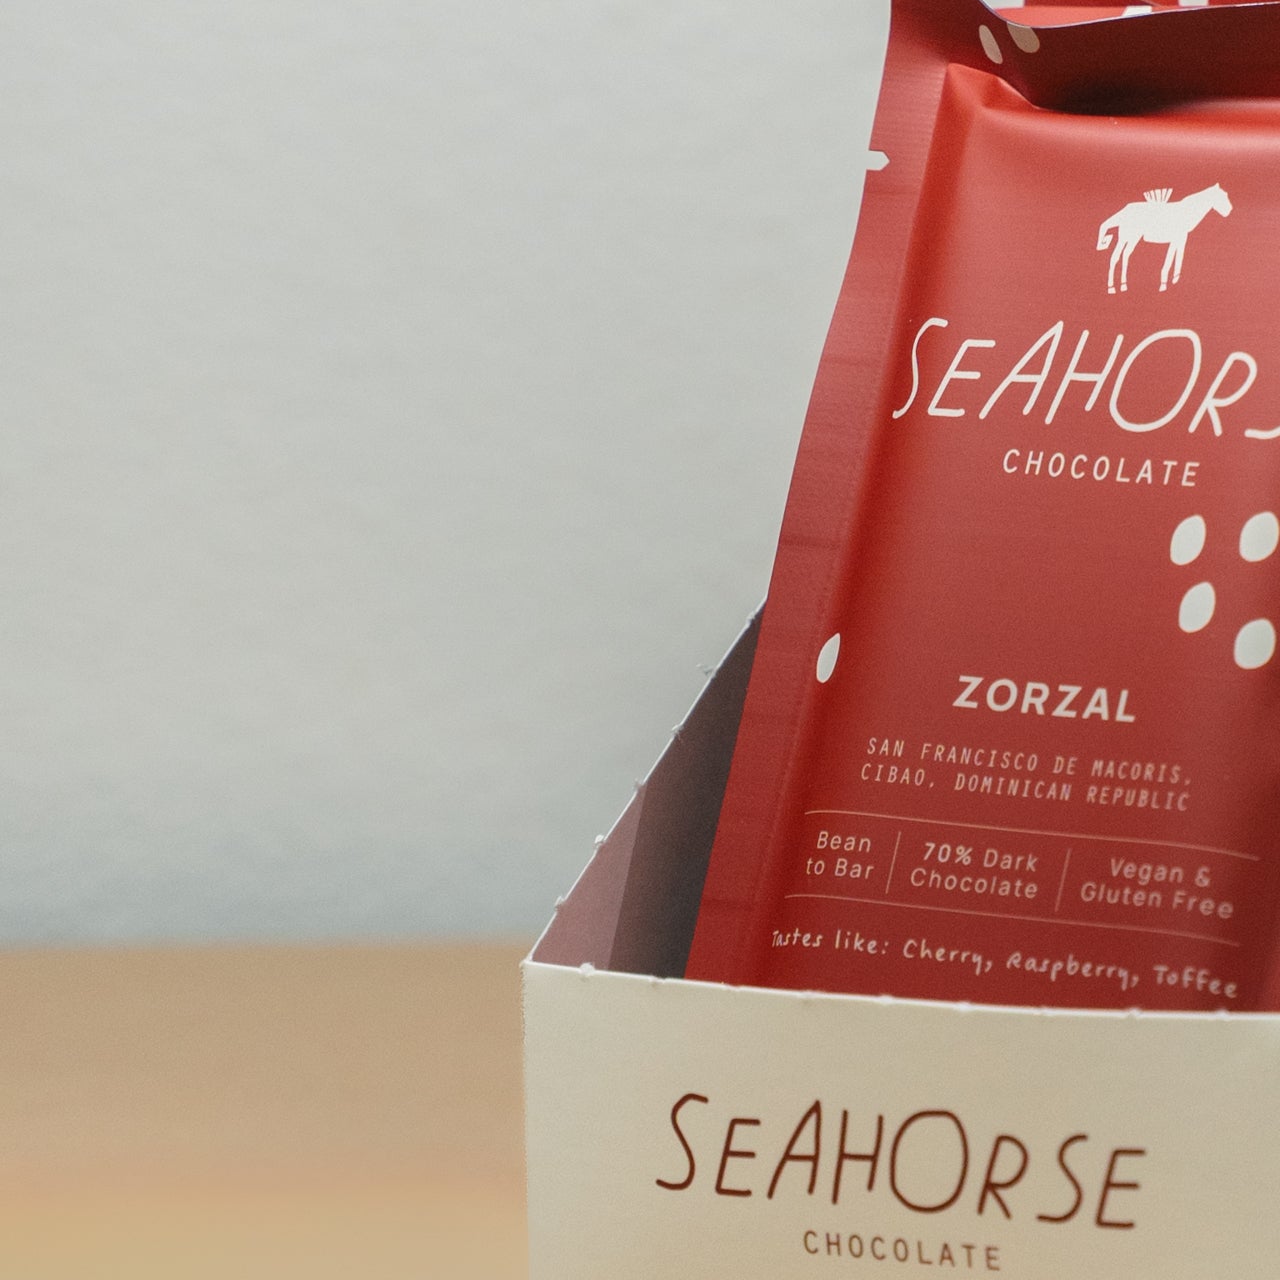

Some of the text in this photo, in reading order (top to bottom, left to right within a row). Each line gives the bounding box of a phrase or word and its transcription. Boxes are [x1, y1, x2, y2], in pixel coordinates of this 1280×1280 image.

[1002, 449, 1200, 487] CHOCOLATE
[952, 675, 1136, 723] ZORZAL
[867, 737, 904, 758] SAN
[920, 743, 1038, 771] FRANCISCO
[1053, 755, 1078, 776] DE
[954, 773, 1072, 801] DOMINICAN
[1086, 785, 1192, 812] REPUBLIC
[816, 831, 871, 852] Bean
[923, 842, 1039, 872] 70% Dark
[806, 857, 874, 879] to Bar
[910, 868, 1038, 899] Chocolate
[1110, 857, 1211, 888] Vegan &
[1081, 882, 1234, 919] Gluten Free
[772, 928, 823, 948] Tastes
[834, 929, 889, 954] like:
[903, 939, 992, 976] Cherry,
[1006, 951, 1139, 991] Raspberry,
[656, 1093, 1146, 1229] SEAHORSE
[803, 1230, 1001, 1272] CHOCOLATE
